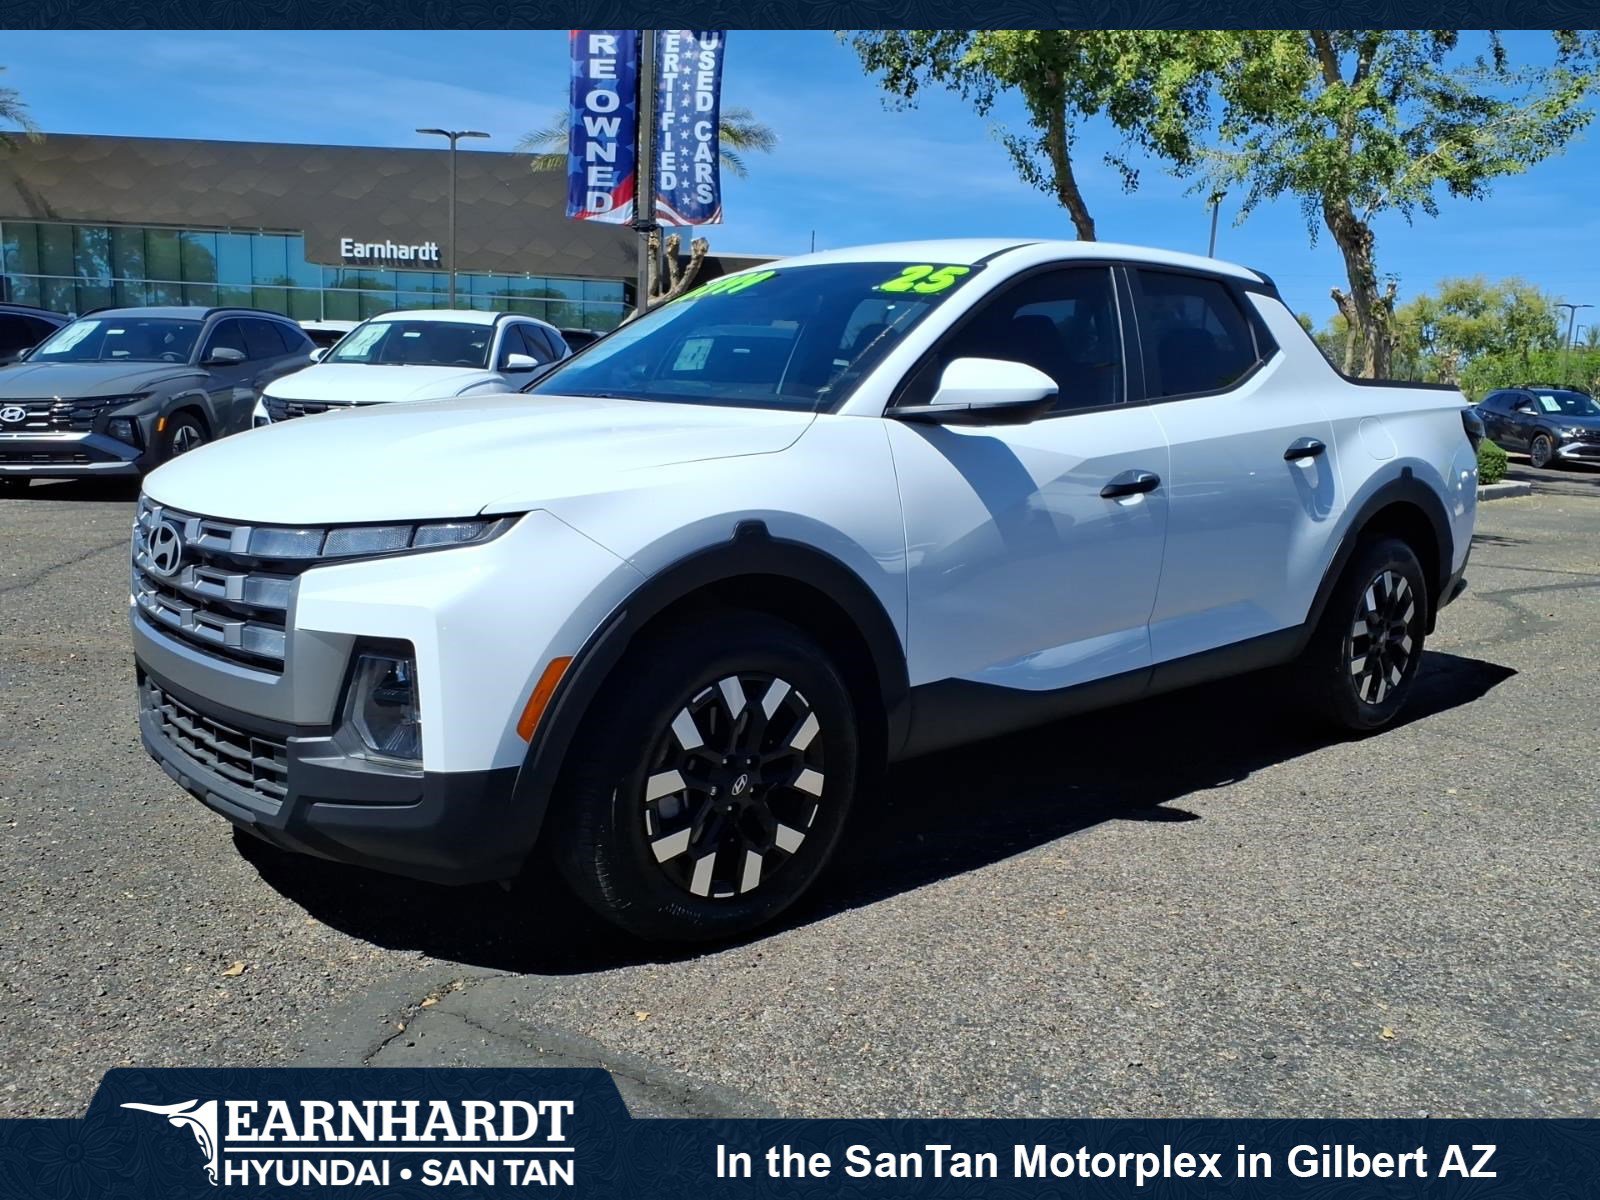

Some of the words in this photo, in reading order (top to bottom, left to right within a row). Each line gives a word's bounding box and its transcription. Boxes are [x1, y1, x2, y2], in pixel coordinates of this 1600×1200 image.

[660, 30, 681, 191] ERTIFIED
[695, 31, 718, 112] USED
[693, 120, 714, 205] CARS
[341, 238, 438, 261] Earnhardt
[880, 264, 970, 293] 25
